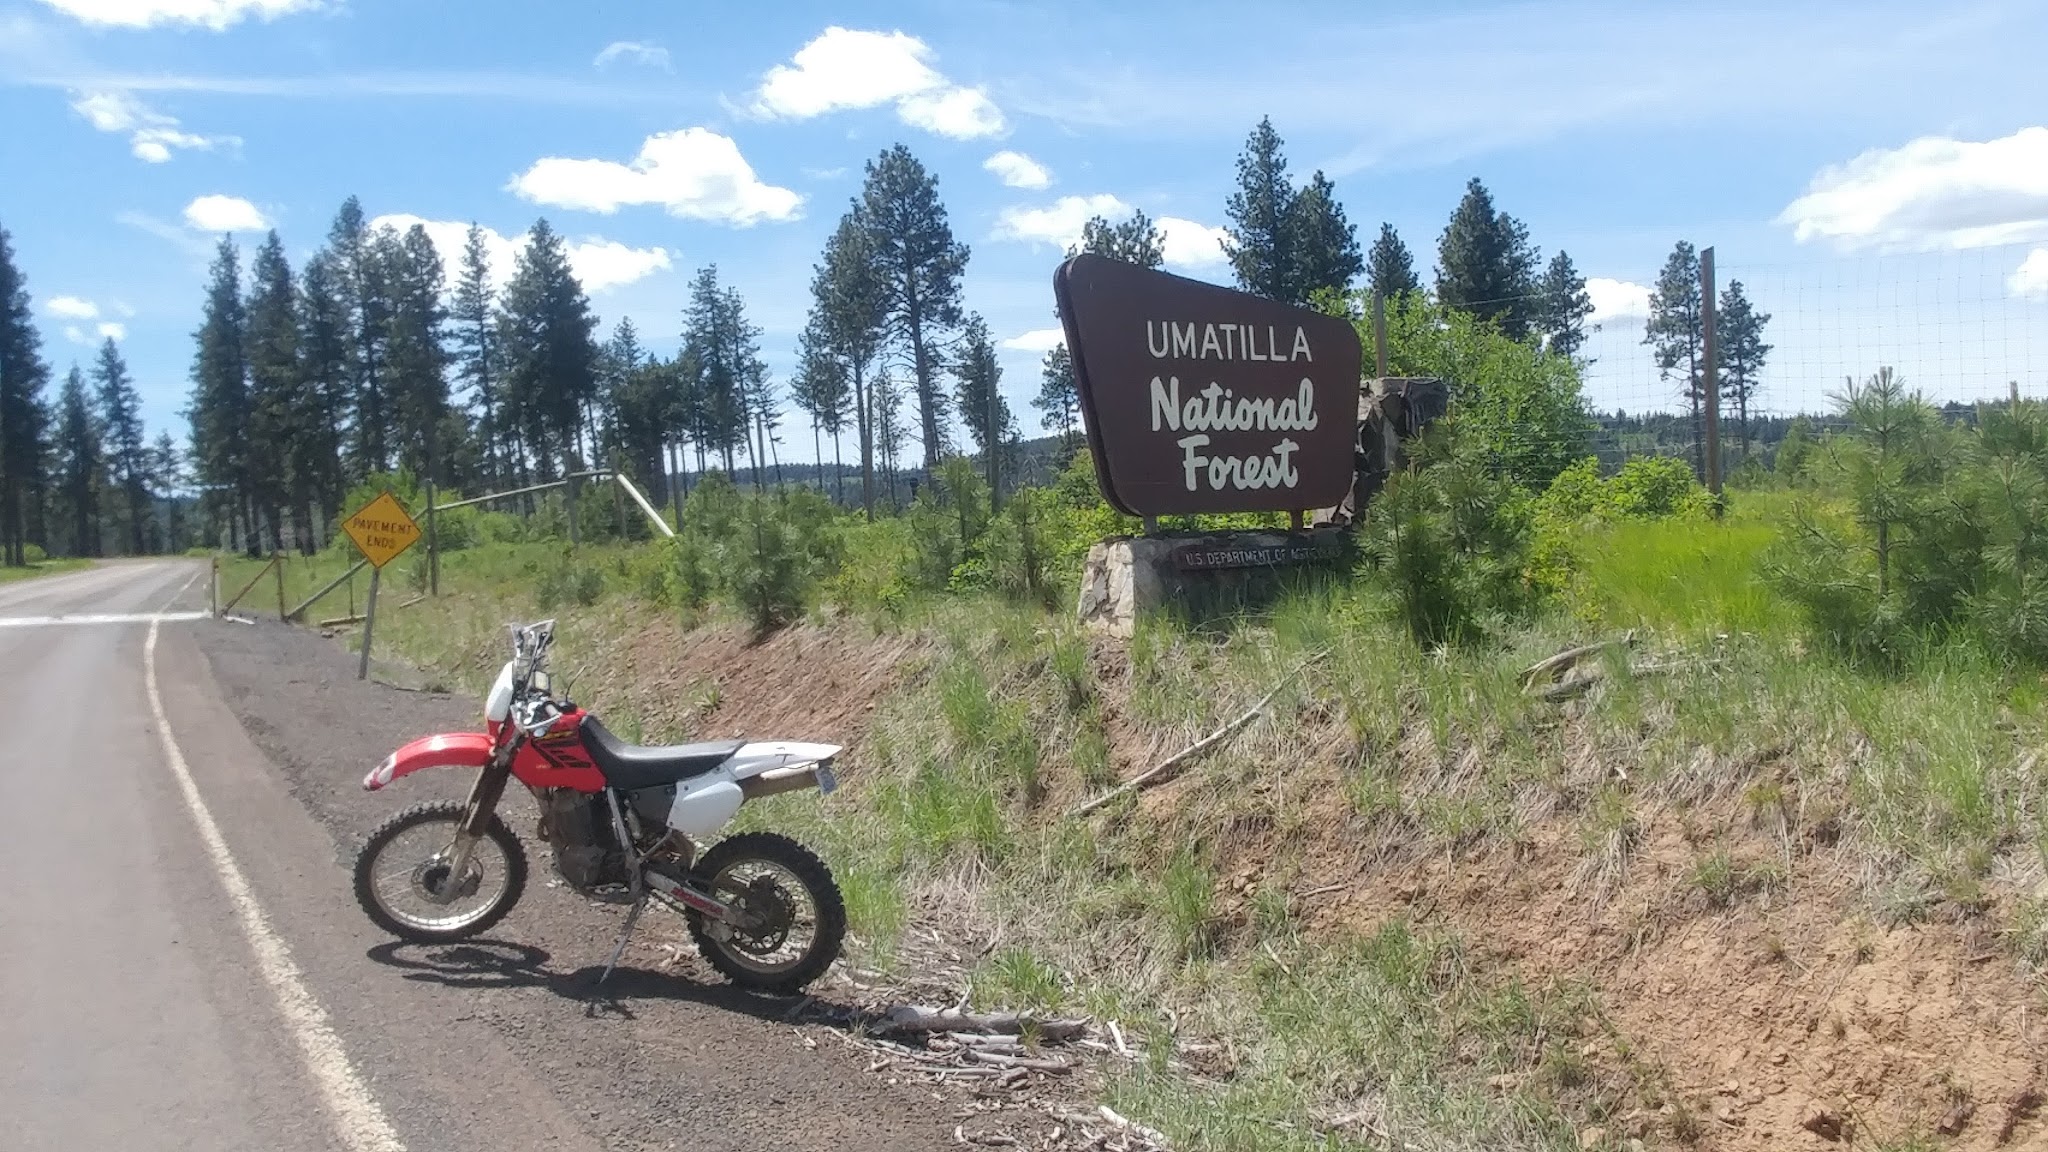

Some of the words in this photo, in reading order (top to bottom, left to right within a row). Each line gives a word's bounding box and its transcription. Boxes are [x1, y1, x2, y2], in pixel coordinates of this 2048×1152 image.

[1147, 320, 1313, 362] UMATILLA
[1150, 376, 1318, 431] National
[1177, 434, 1300, 491] Forest
[352, 517, 412, 535] PAVEMENT
[367, 535, 396, 549] ENDS
[1206, 549, 1270, 565] DEPARTMENT
